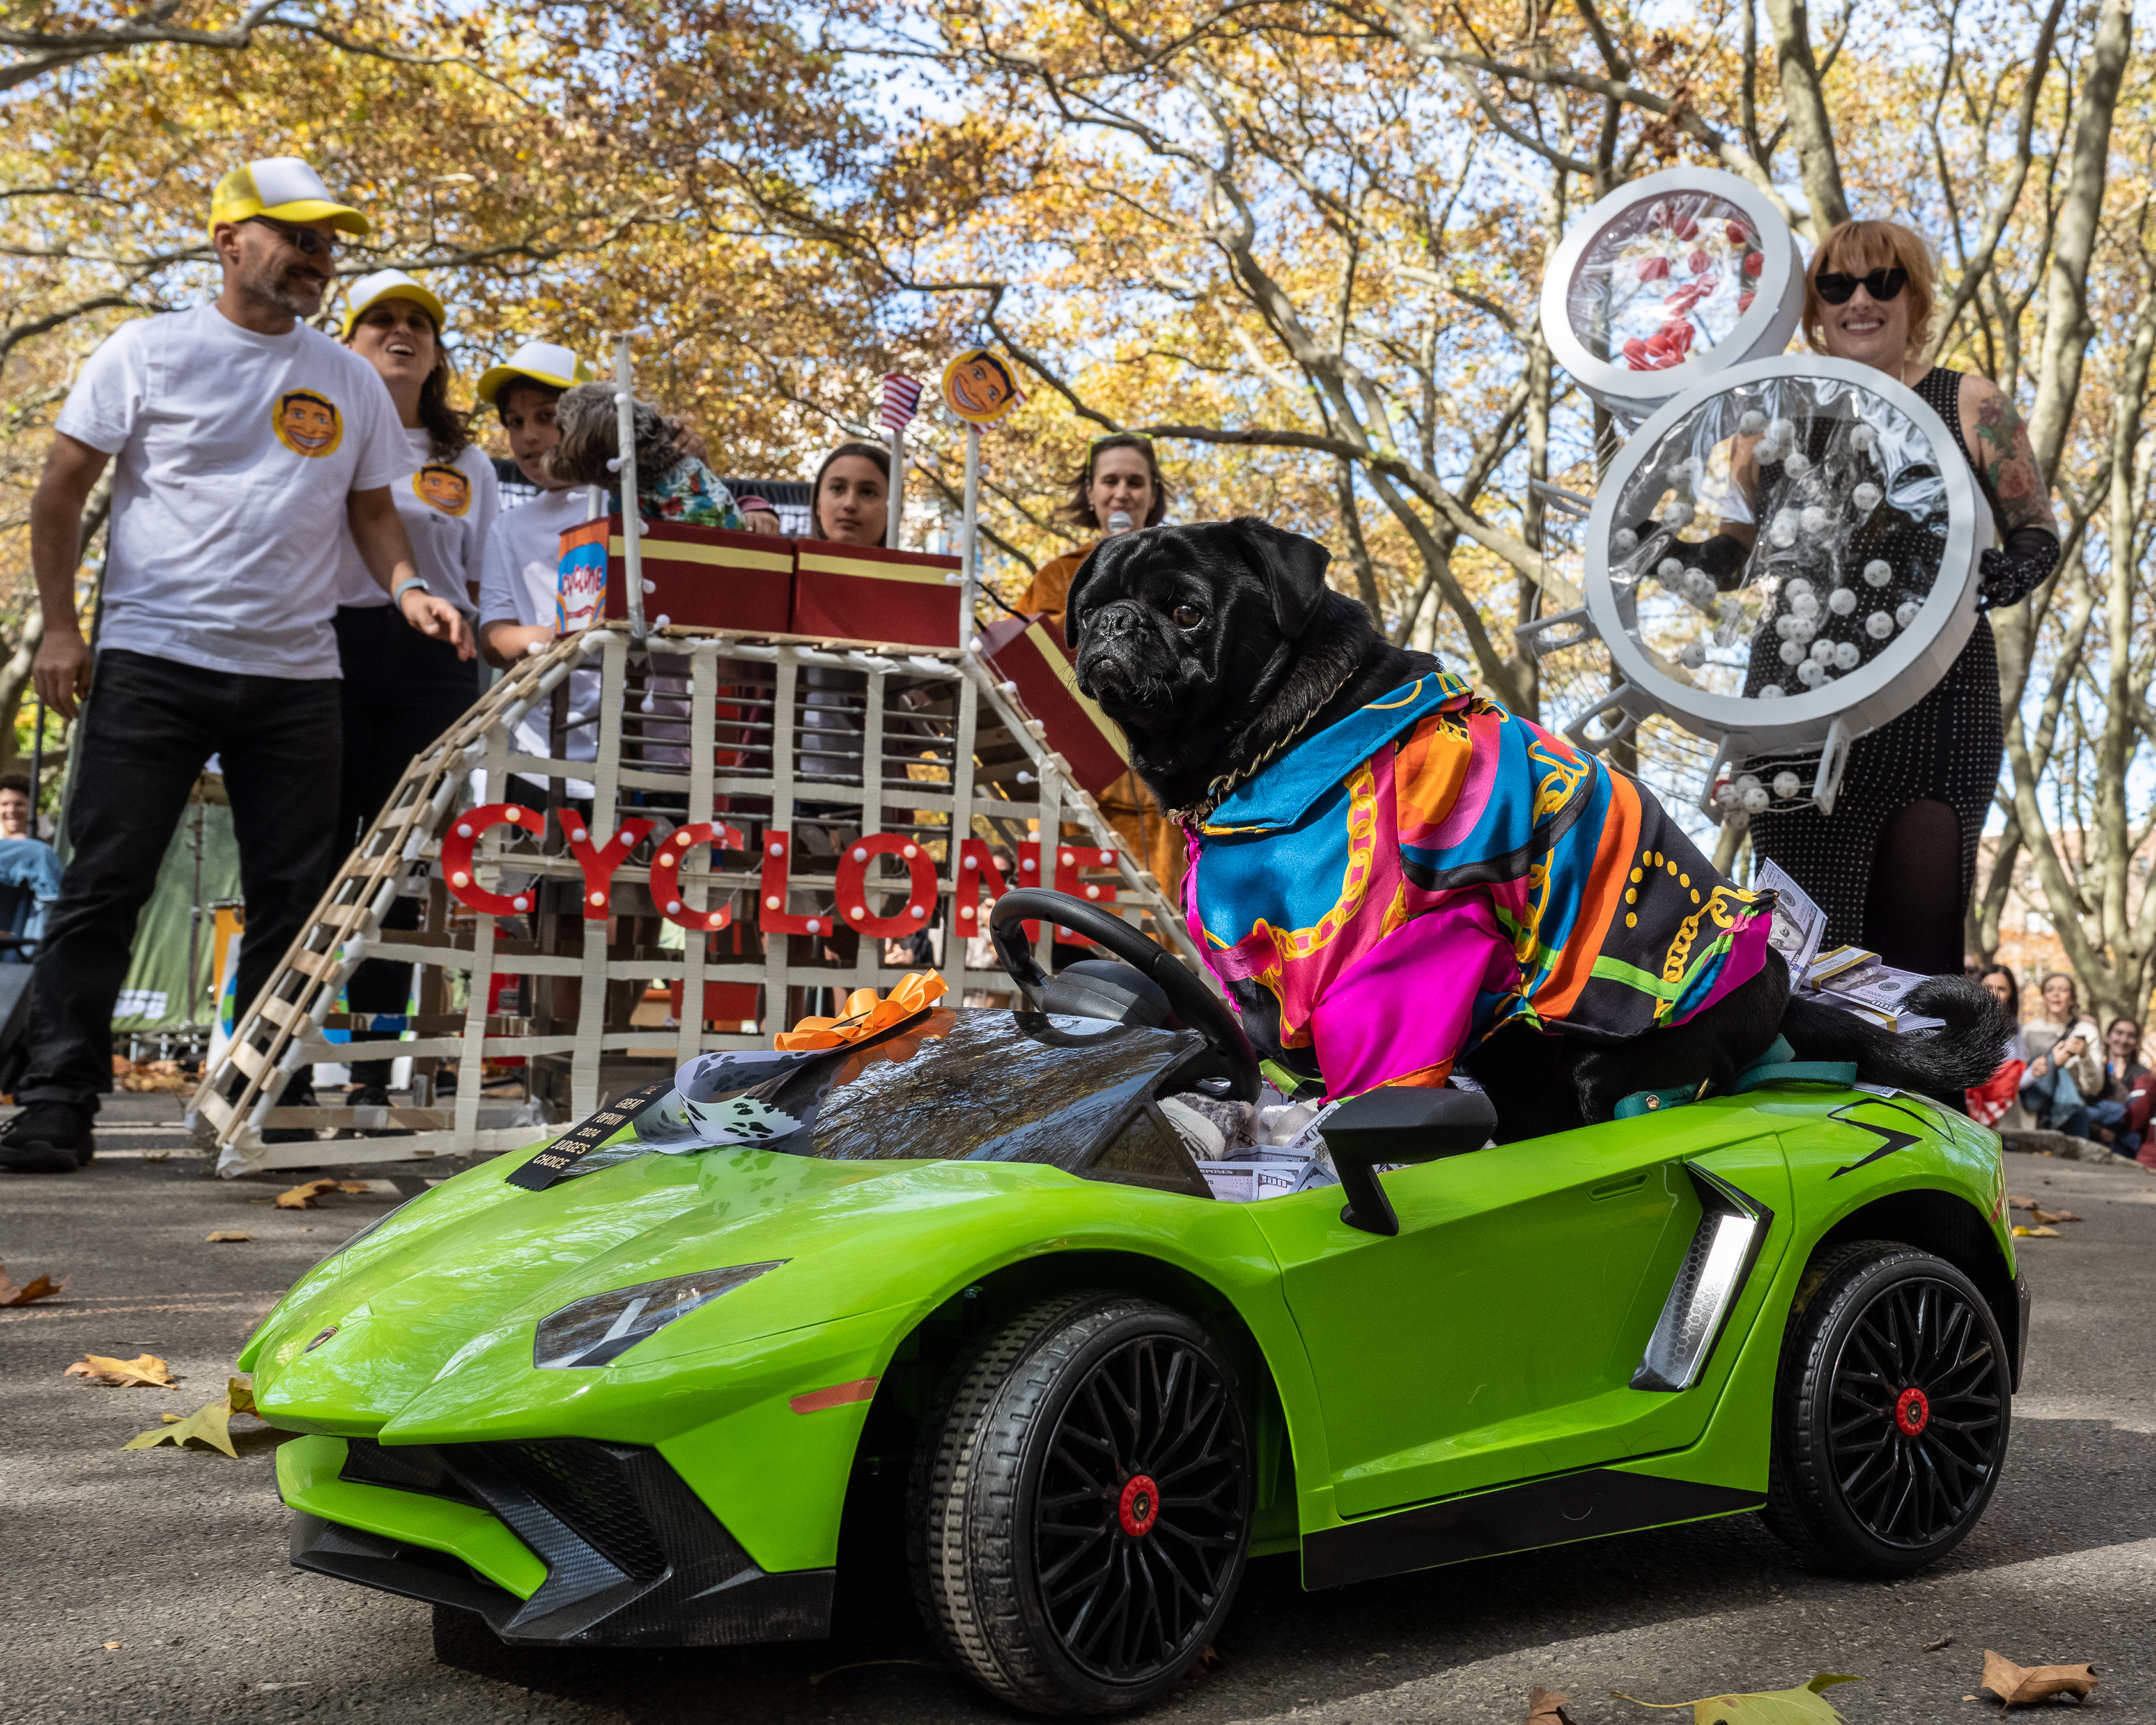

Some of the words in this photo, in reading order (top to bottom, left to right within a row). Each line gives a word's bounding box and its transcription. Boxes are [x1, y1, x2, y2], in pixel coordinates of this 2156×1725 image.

[441, 803, 1119, 945] CYCLONE
[640, 1085, 662, 1095] THE
[614, 1098, 645, 1110] GREAT
[591, 1112, 626, 1126] PUPKIN
[576, 1127, 602, 1138] 2024
[550, 1139, 591, 1154] JUDGE'S
[533, 1154, 571, 1169] CHOICE
